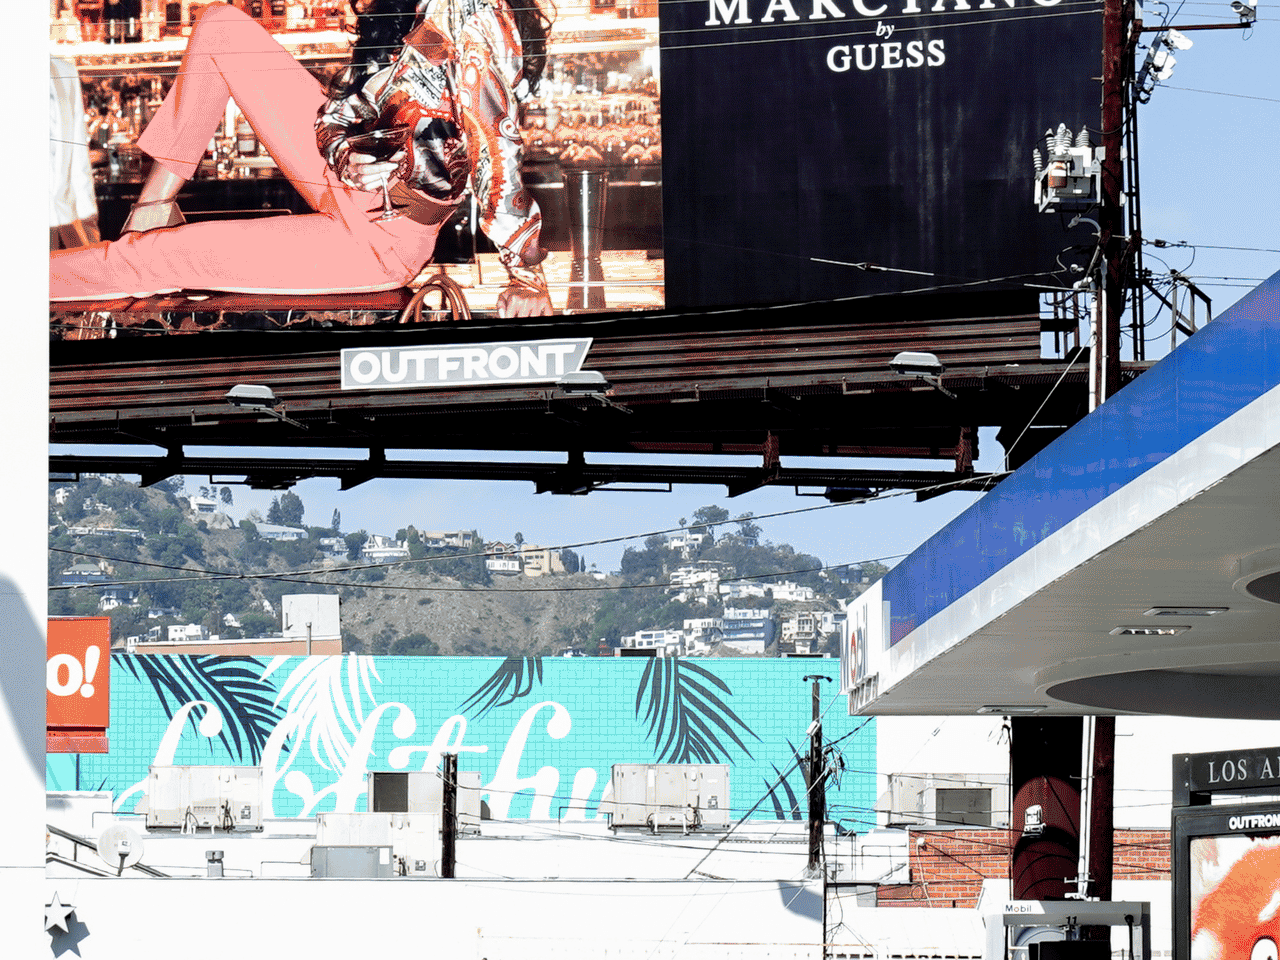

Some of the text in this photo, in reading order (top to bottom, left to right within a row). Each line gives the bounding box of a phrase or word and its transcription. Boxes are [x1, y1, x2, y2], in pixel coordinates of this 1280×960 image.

[876, 21, 895, 39] by
[826, 40, 946, 72] GUESS
[348, 343, 575, 385] OUTFRONT
[1208, 759, 1248, 784] LOS
[1005, 904, 1032, 912] Mobil
[1065, 916, 1078, 925] 11
